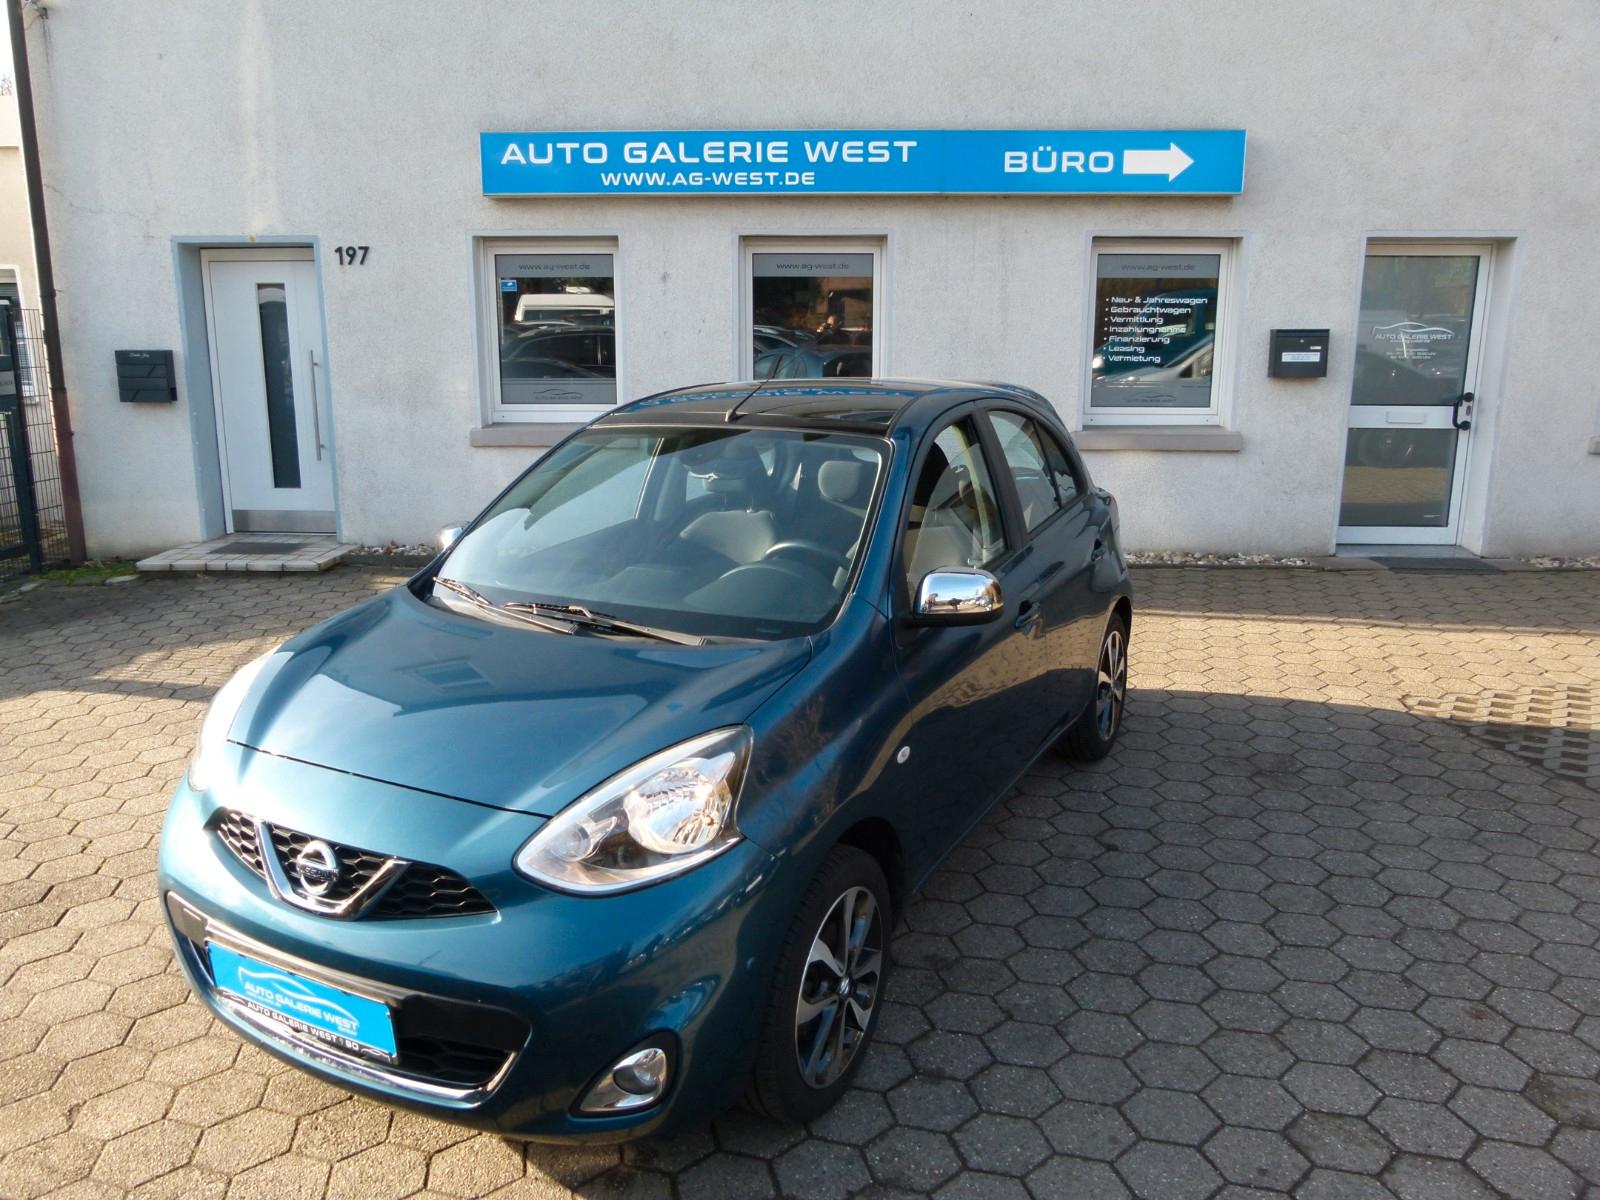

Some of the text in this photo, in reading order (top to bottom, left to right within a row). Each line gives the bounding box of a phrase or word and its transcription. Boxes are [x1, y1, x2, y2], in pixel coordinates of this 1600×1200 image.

[501, 140, 918, 164] AUTO GALERIE WEST
[1004, 145, 1114, 173] BÜRO
[601, 171, 816, 186] WWW.AG-WEST.DE
[334, 246, 370, 266] 197
[1111, 296, 1208, 305] Neu- & Jahreswagen
[1110, 306, 1192, 315] Gebrauchtwagen
[1109, 316, 1164, 325] Vermittlung
[1109, 325, 1187, 334] Inzahlungnahme
[1108, 335, 1170, 344] Finanzierung
[1108, 344, 1145, 353] Leasing
[1108, 354, 1161, 363] Vermietung
[244, 981, 275, 1000] AUTO
[322, 1010, 358, 1030] WEST
[247, 1002, 271, 1017] AUTO
[271, 1011, 309, 1033] GALERIE
[310, 1026, 338, 1042] WEST
